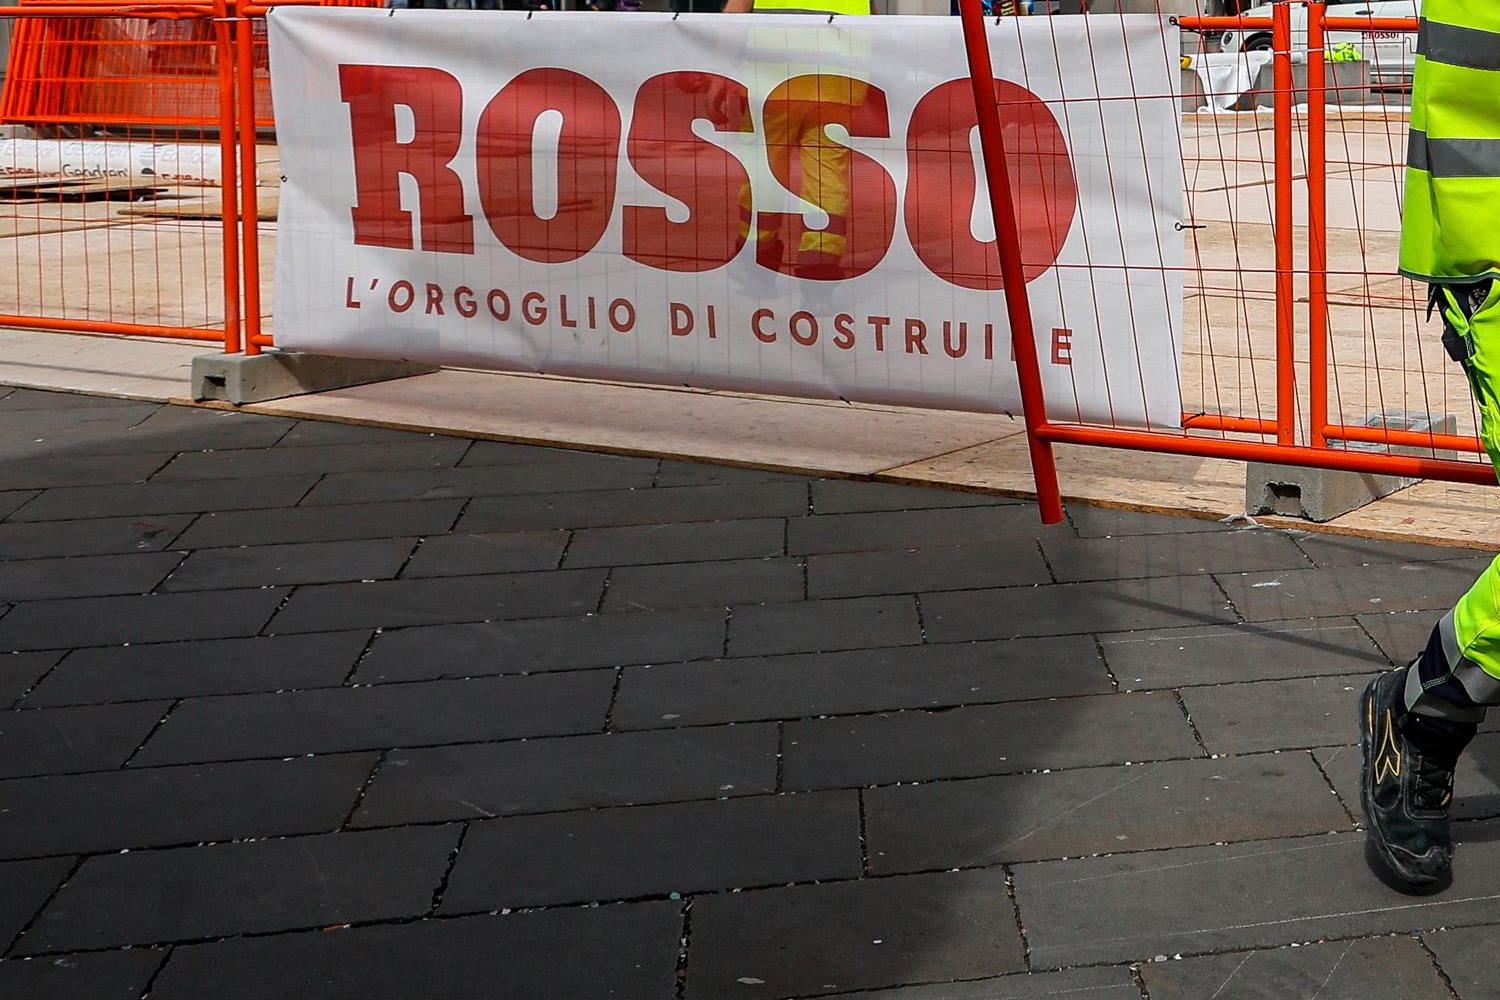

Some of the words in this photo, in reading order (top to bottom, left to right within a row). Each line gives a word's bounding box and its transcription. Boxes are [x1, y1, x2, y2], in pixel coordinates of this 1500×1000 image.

[338, 63, 1077, 291] ROSSO
[345, 276, 637, 333] L'ORGOGLIO
[670, 302, 717, 339] DI
[751, 307, 1073, 366] COSTRUIE
